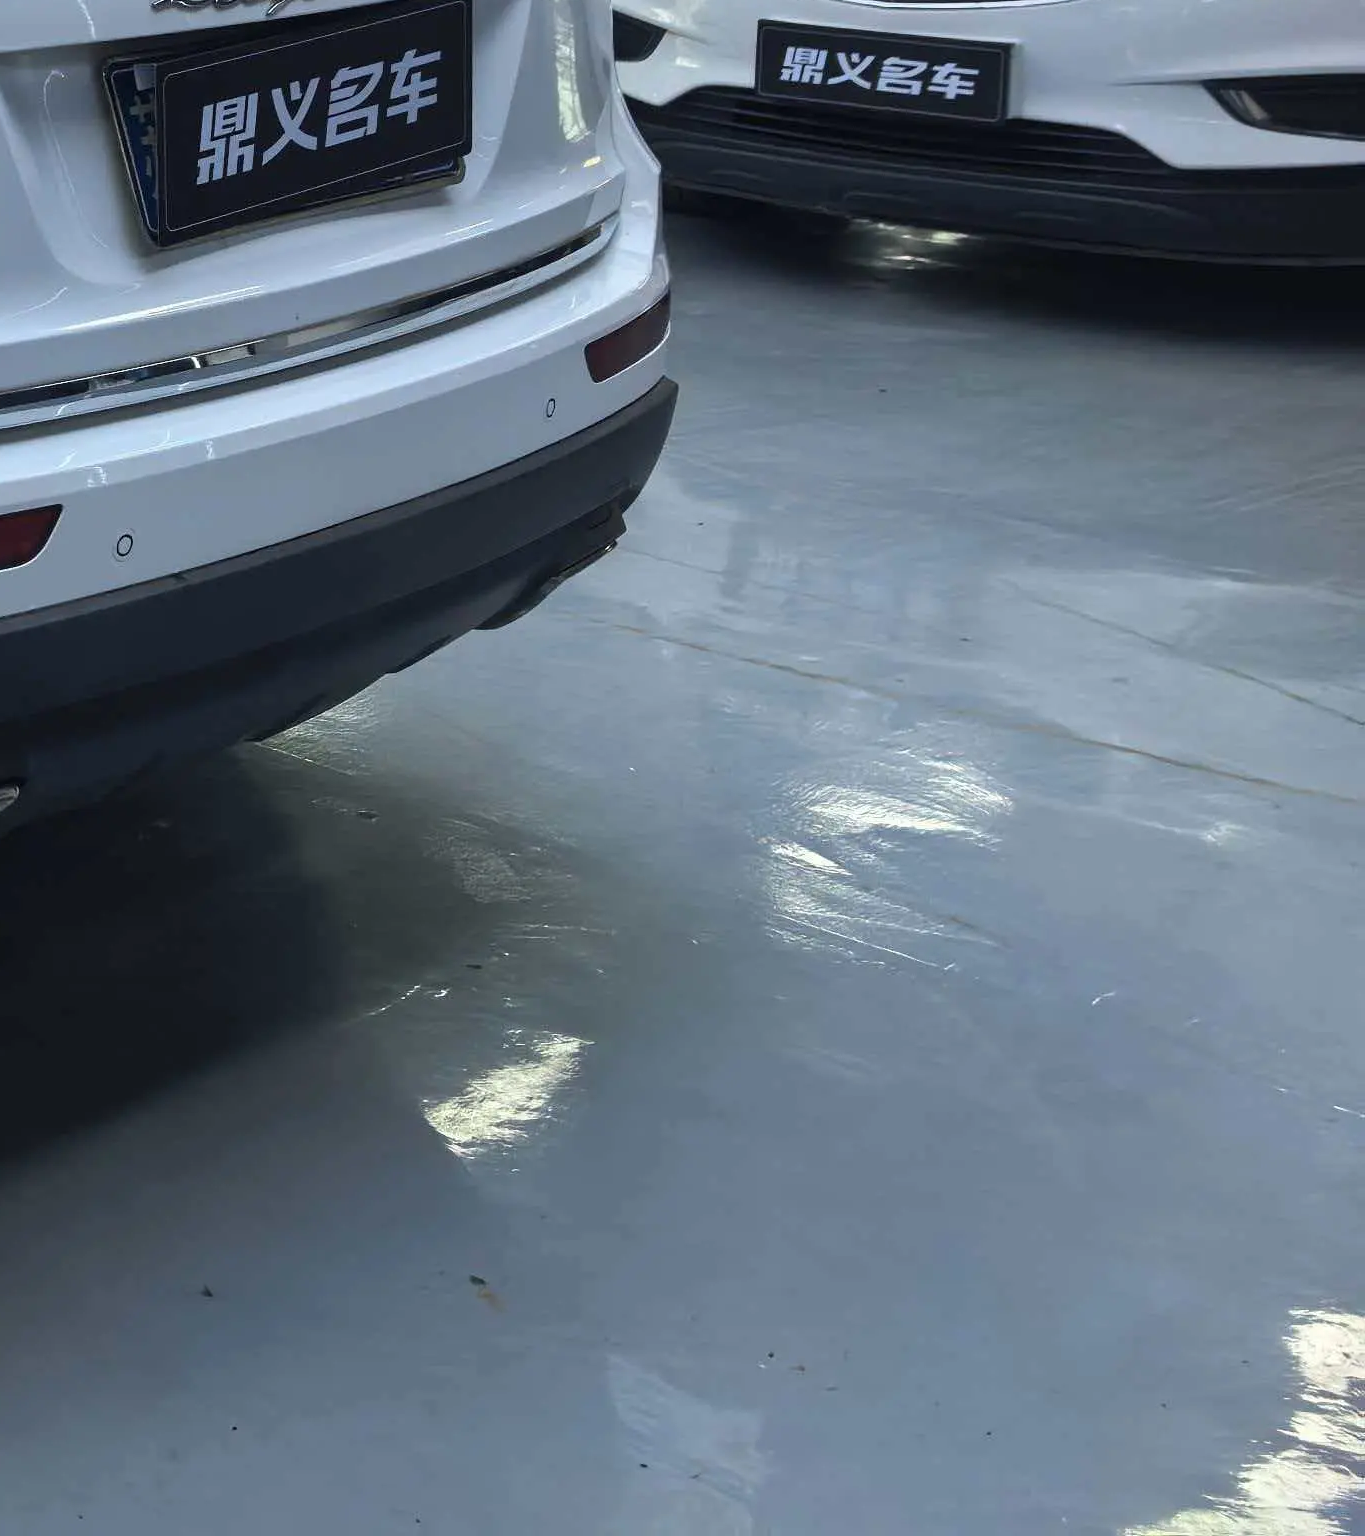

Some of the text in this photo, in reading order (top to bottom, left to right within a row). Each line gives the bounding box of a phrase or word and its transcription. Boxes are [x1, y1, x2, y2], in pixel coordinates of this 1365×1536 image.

[196, 47, 442, 185] 鼎义名车
[780, 45, 980, 100] 鼎义名车
